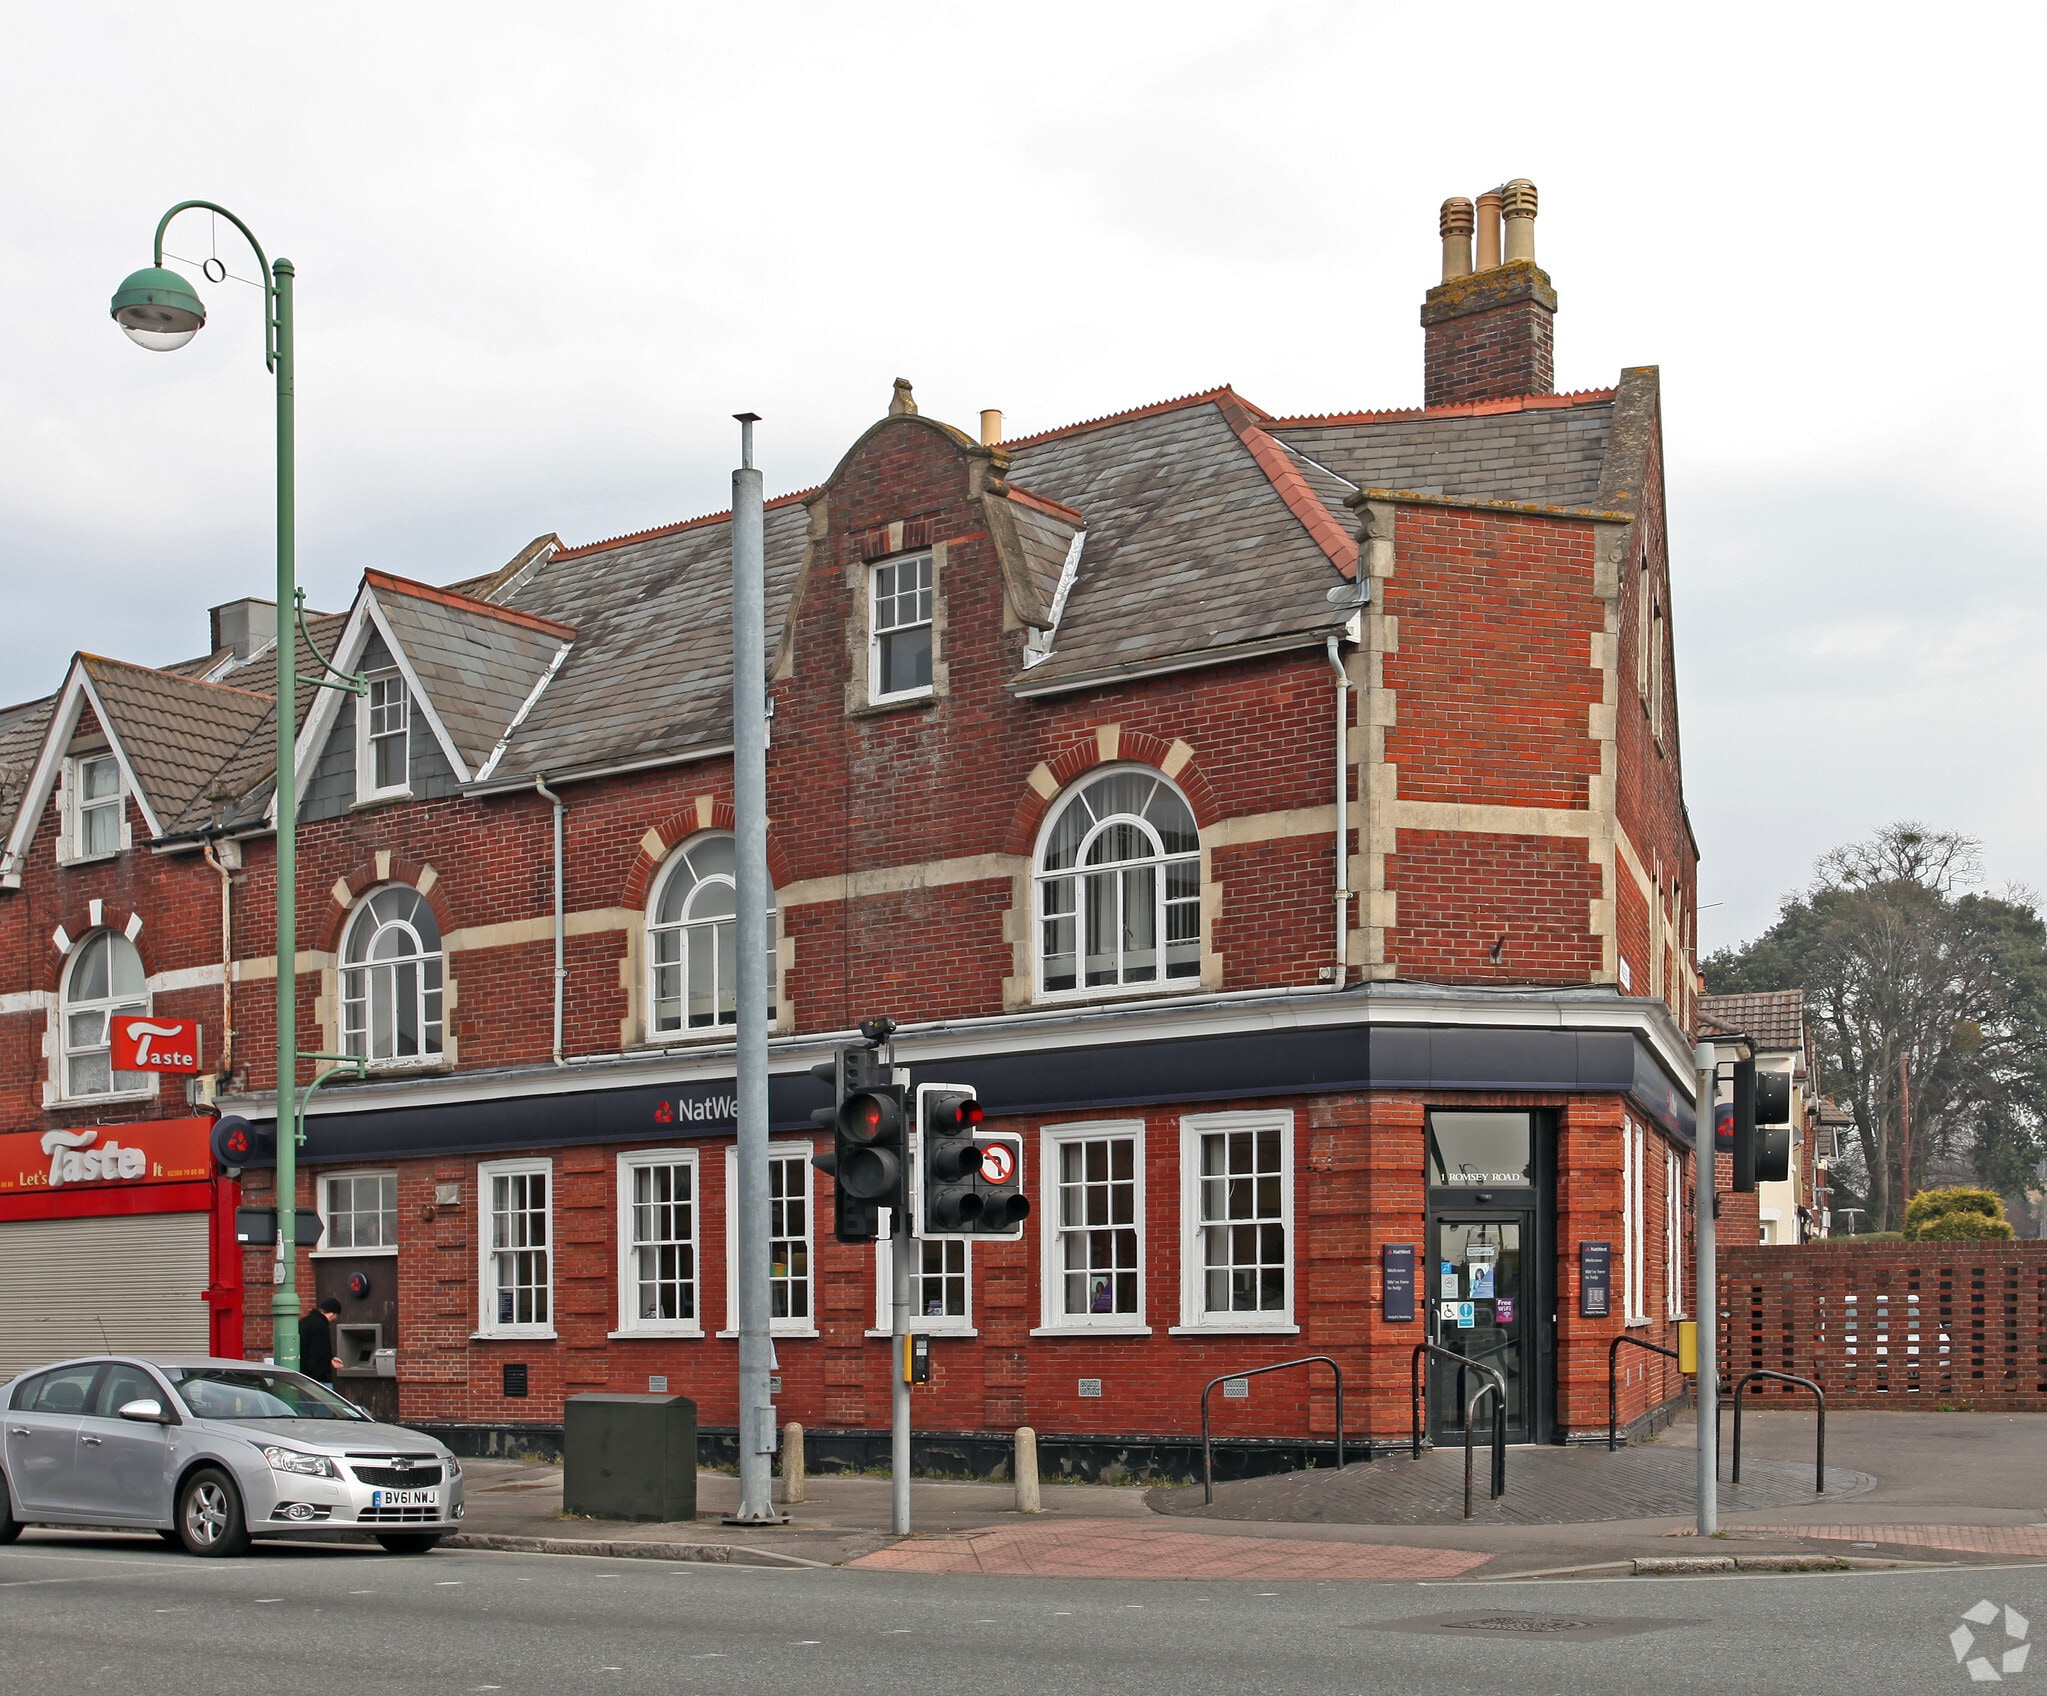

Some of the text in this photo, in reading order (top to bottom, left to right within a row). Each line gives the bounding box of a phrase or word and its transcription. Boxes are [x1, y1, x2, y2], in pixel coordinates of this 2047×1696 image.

[126, 1021, 193, 1066] Taste
[679, 1095, 738, 1122] NatWe
[19, 1170, 48, 1186] Let's
[40, 1129, 147, 1187] Taste
[152, 1161, 163, 1177] It
[1441, 1173, 1520, 1181] 1 ROMSEY ROAD
[385, 1491, 435, 1504] BV61 NWJ
